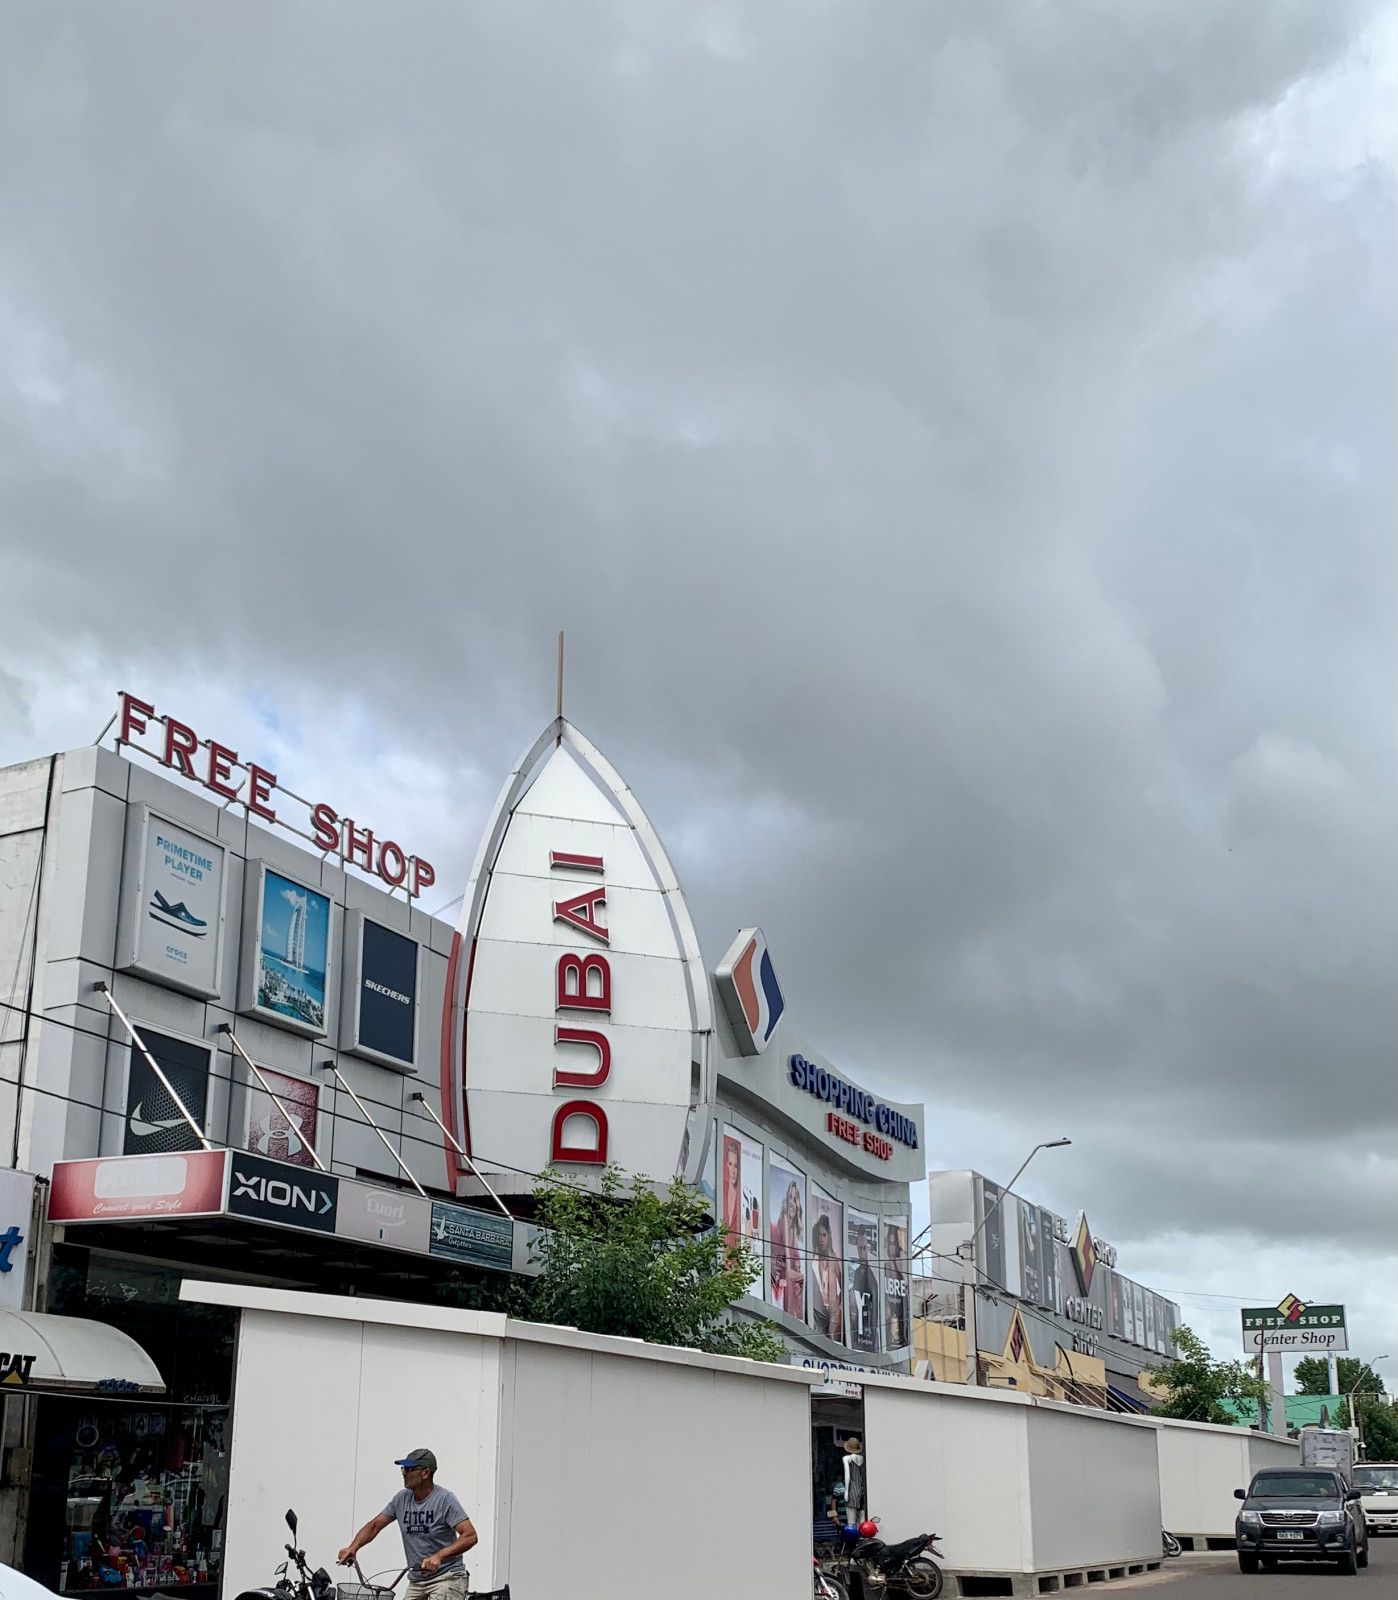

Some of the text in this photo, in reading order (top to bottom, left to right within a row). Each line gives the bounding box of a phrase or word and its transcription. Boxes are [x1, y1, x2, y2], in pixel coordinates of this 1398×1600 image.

[115, 691, 435, 898] FREE SHOP
[156, 836, 213, 871] PRIMETIME
[164, 855, 203, 881] PLAYER
[166, 945, 188, 959] crocs
[364, 979, 411, 1005] SKECHERS
[550, 850, 612, 1168] DUBAI
[789, 1054, 918, 1149] SHOPPING CHINA
[827, 1112, 893, 1160] FREE SHOP
[155, 1200, 183, 1211] Style
[232, 1171, 317, 1213] XION
[448, 1225, 512, 1246] SANTA BARBARA
[1065, 1295, 1104, 1331] CENTER
[1245, 1315, 1341, 1327] FREE SHOP
[1072, 1328, 1099, 1357] SHOP
[1253, 1331, 1336, 1347] Center Shop
[0, 1353, 36, 1385] CAT
